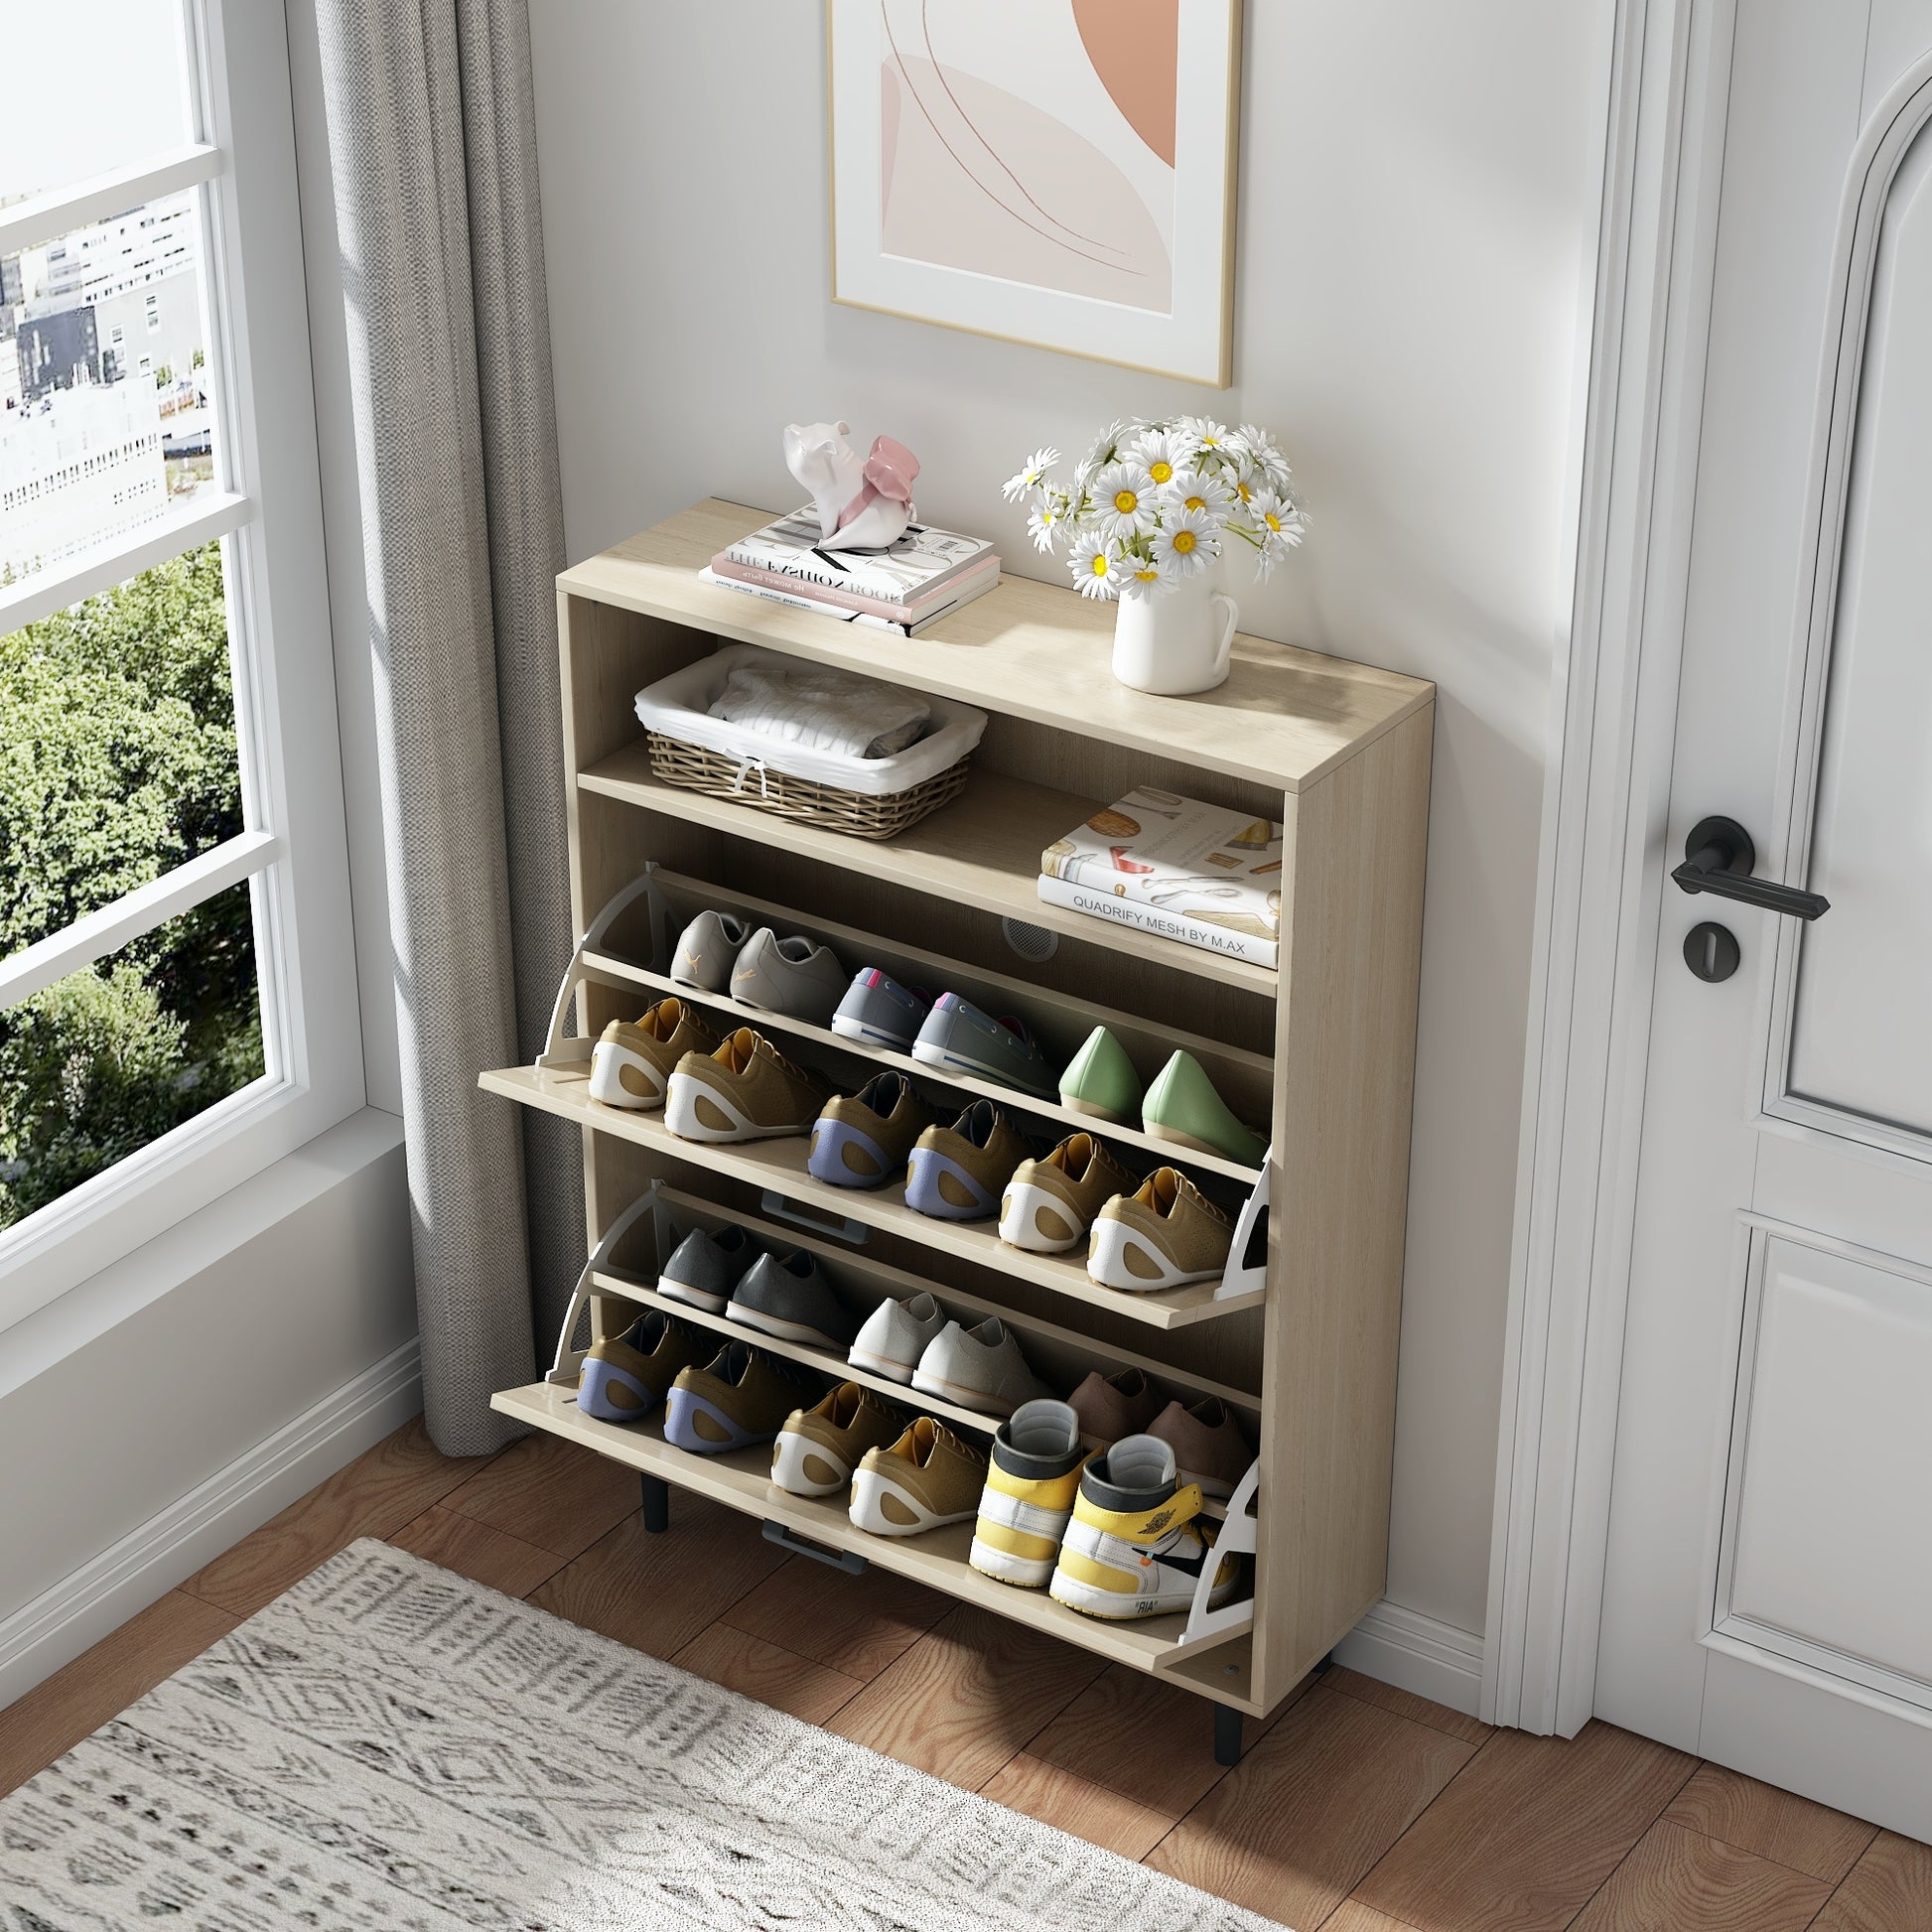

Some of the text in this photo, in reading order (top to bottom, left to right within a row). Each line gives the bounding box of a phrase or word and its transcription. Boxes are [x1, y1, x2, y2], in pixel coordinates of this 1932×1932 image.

[1073, 896, 1246, 954] QUADRIFY MESH BY M.AX
